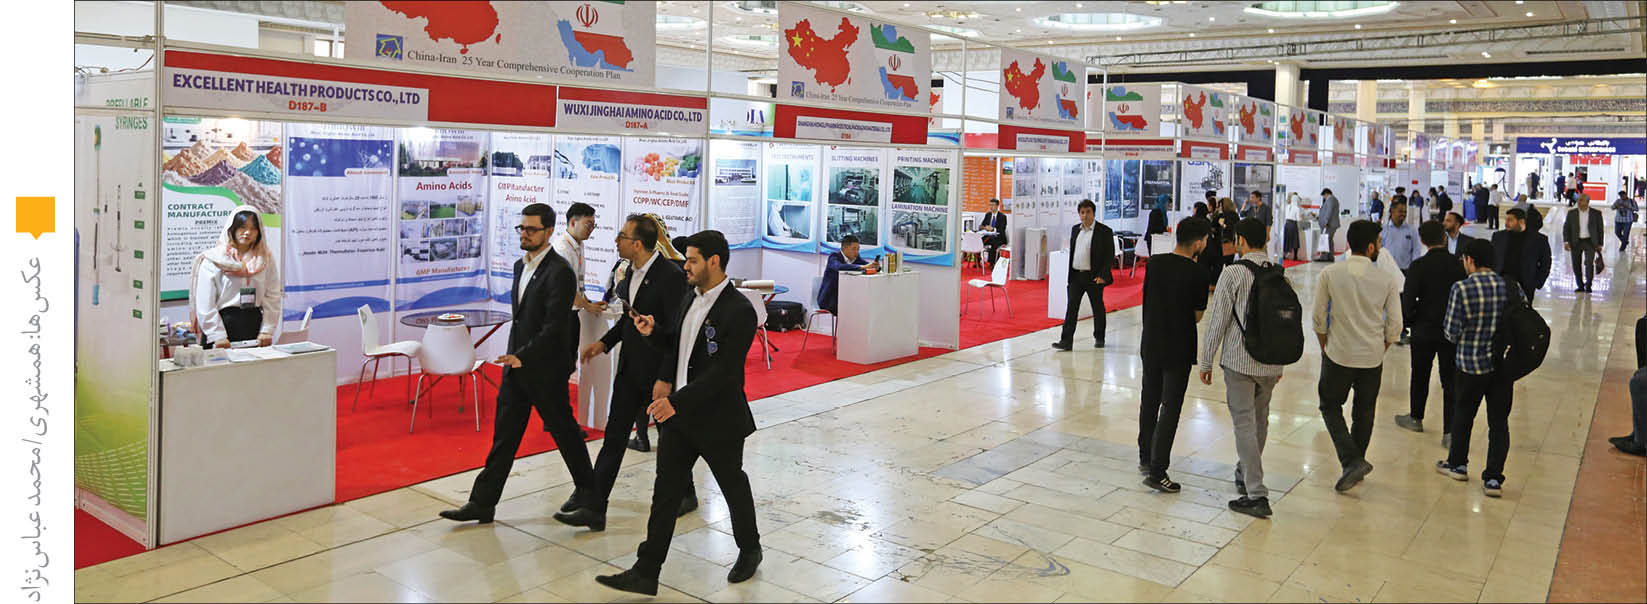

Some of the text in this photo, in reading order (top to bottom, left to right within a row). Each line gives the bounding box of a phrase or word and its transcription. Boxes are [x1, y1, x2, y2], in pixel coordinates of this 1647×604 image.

[407, 50, 621, 80] China-Iran 25 Year Comprehensive Cooperation Plan
[173, 74, 254, 92] EXCELLENT
[256, 81, 308, 97] HEALTH
[310, 85, 374, 102] PRODUCTS
[288, 101, 327, 112] D187-B
[654, 109, 672, 120] ACID
[416, 181, 472, 190] Amino Acids
